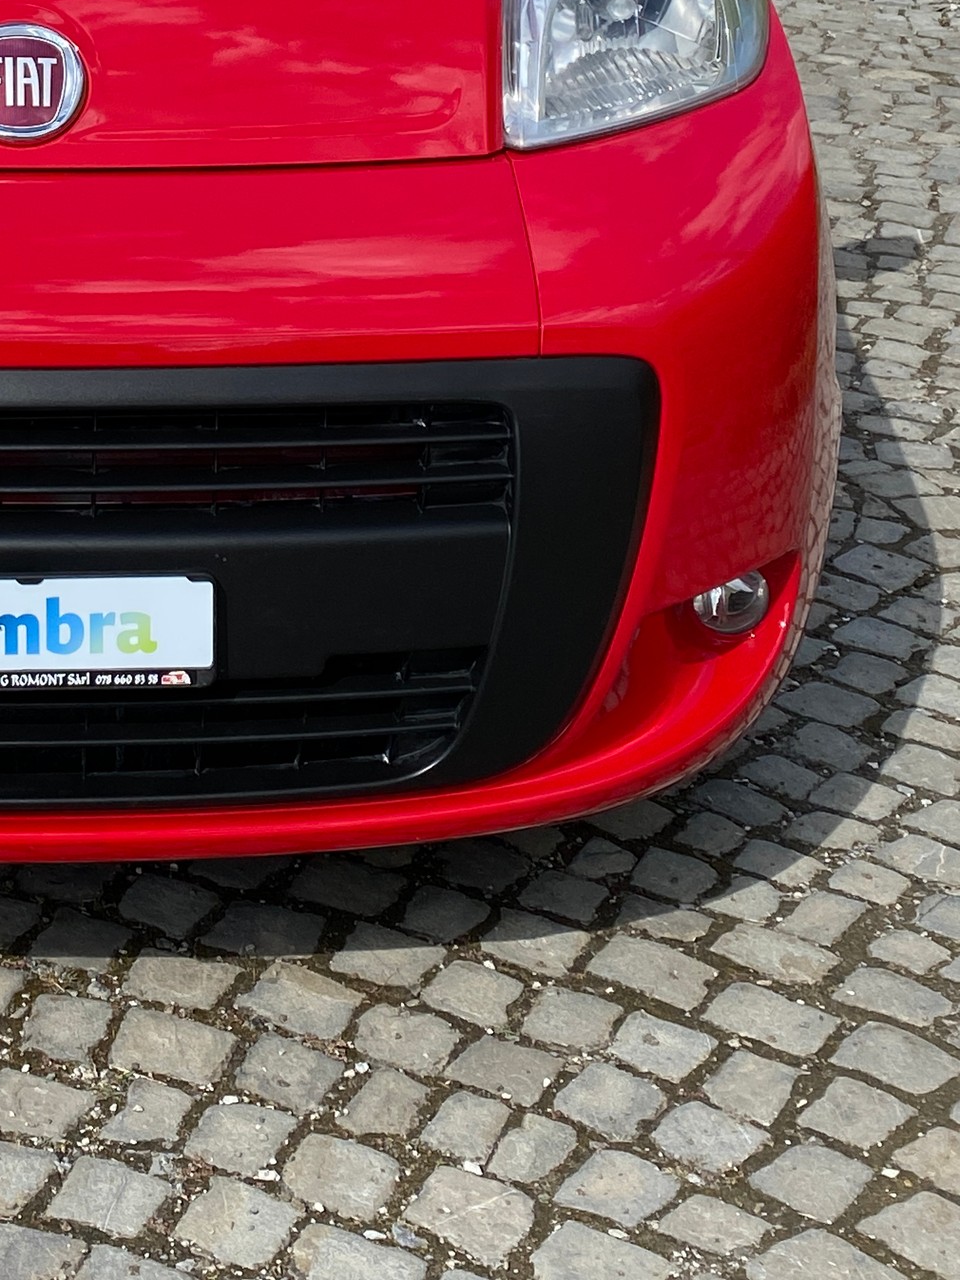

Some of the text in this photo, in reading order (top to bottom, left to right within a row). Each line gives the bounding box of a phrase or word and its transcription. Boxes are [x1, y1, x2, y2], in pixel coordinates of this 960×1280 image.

[11, 673, 66, 686] ROMONT
[95, 674, 112, 685] 078
[114, 674, 132, 685] 660
